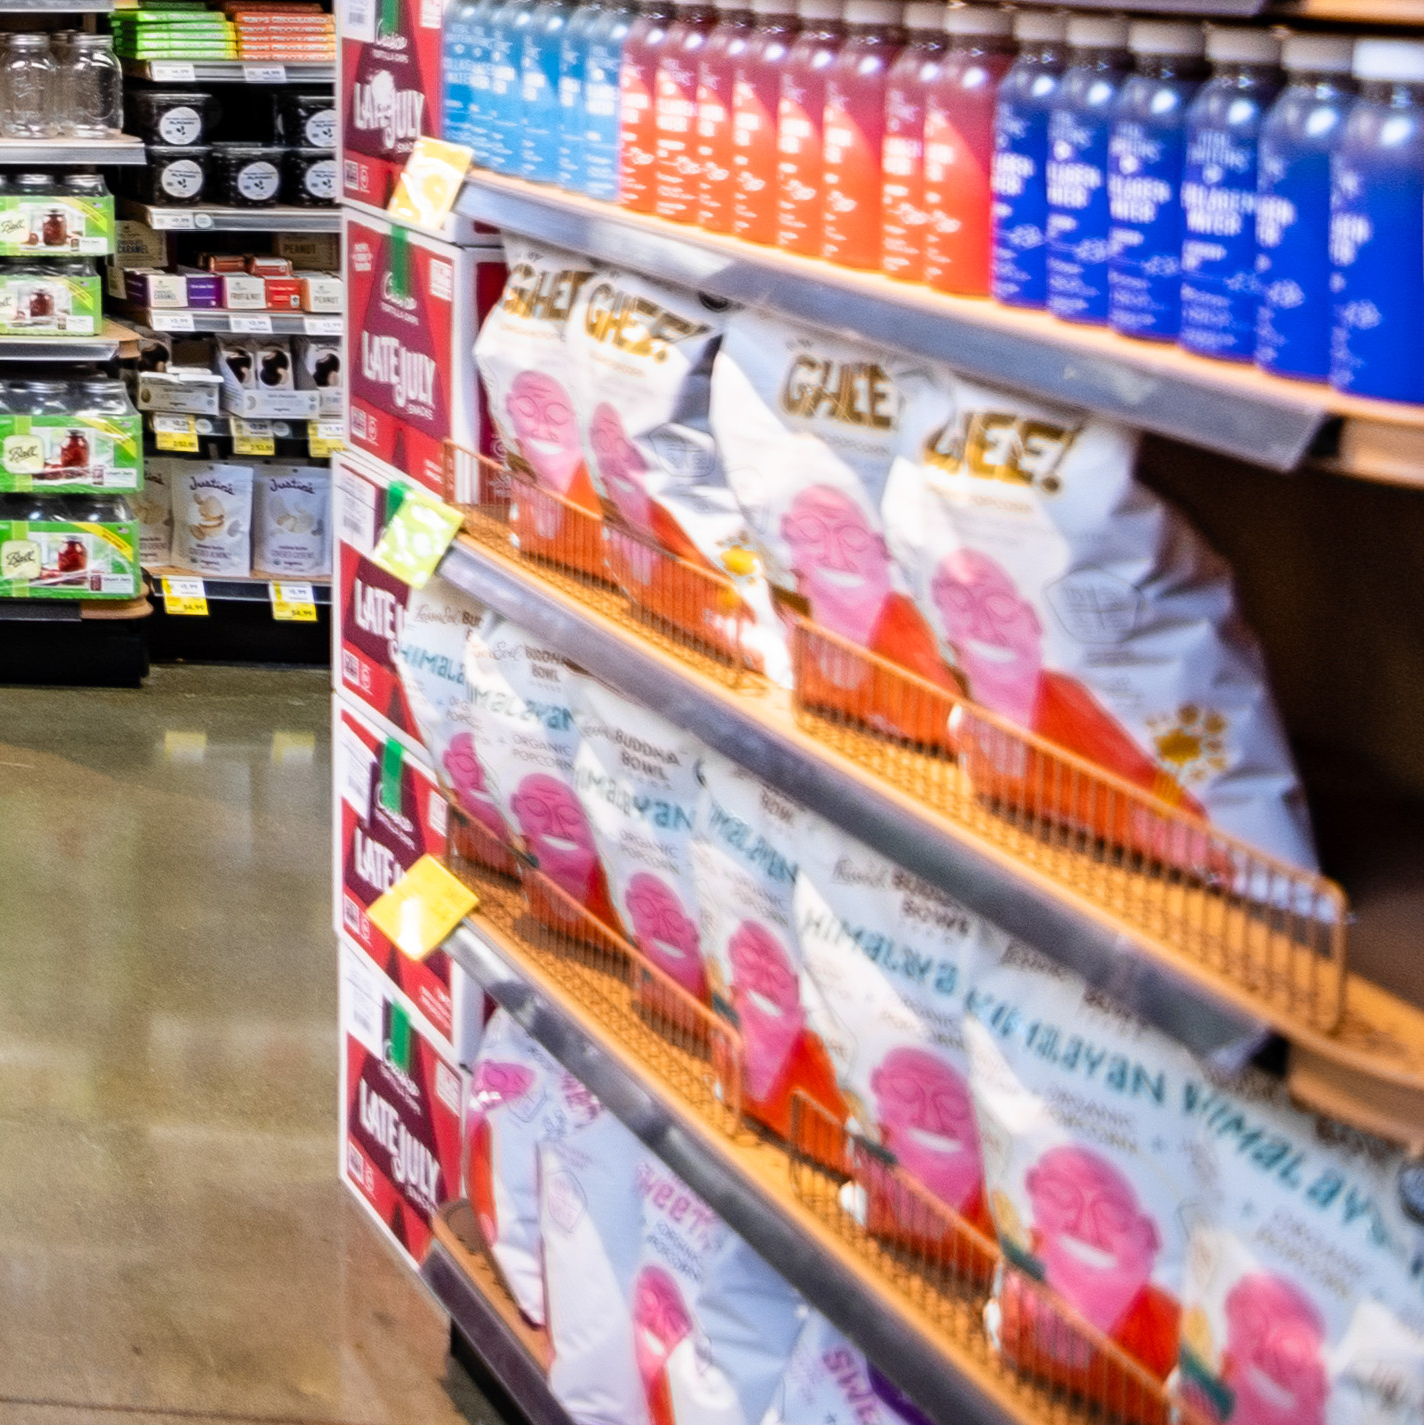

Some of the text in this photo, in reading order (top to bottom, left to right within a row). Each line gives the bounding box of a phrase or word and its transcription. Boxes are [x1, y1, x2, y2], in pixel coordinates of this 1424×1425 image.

[1, 219, 23, 232] Ball
[284, 244, 316, 254] PEANUT
[154, 293, 177, 301] CARAMEL
[315, 296, 339, 304] PEANUT
[362, 329, 436, 409] LATE JULY
[407, 404, 434, 420] SNACKS
[8, 446, 38, 460] Ball
[190, 476, 235, 496] Justin's
[270, 478, 315, 494] Justin's
[5, 550, 35, 566] Ball
[355, 577, 396, 640] LATE
[512, 734, 571, 756] ORGANIC
[614, 728, 680, 766] BUDDHA
[622, 751, 670, 781] BOWL
[360, 1078, 441, 1205] LATE JULY
